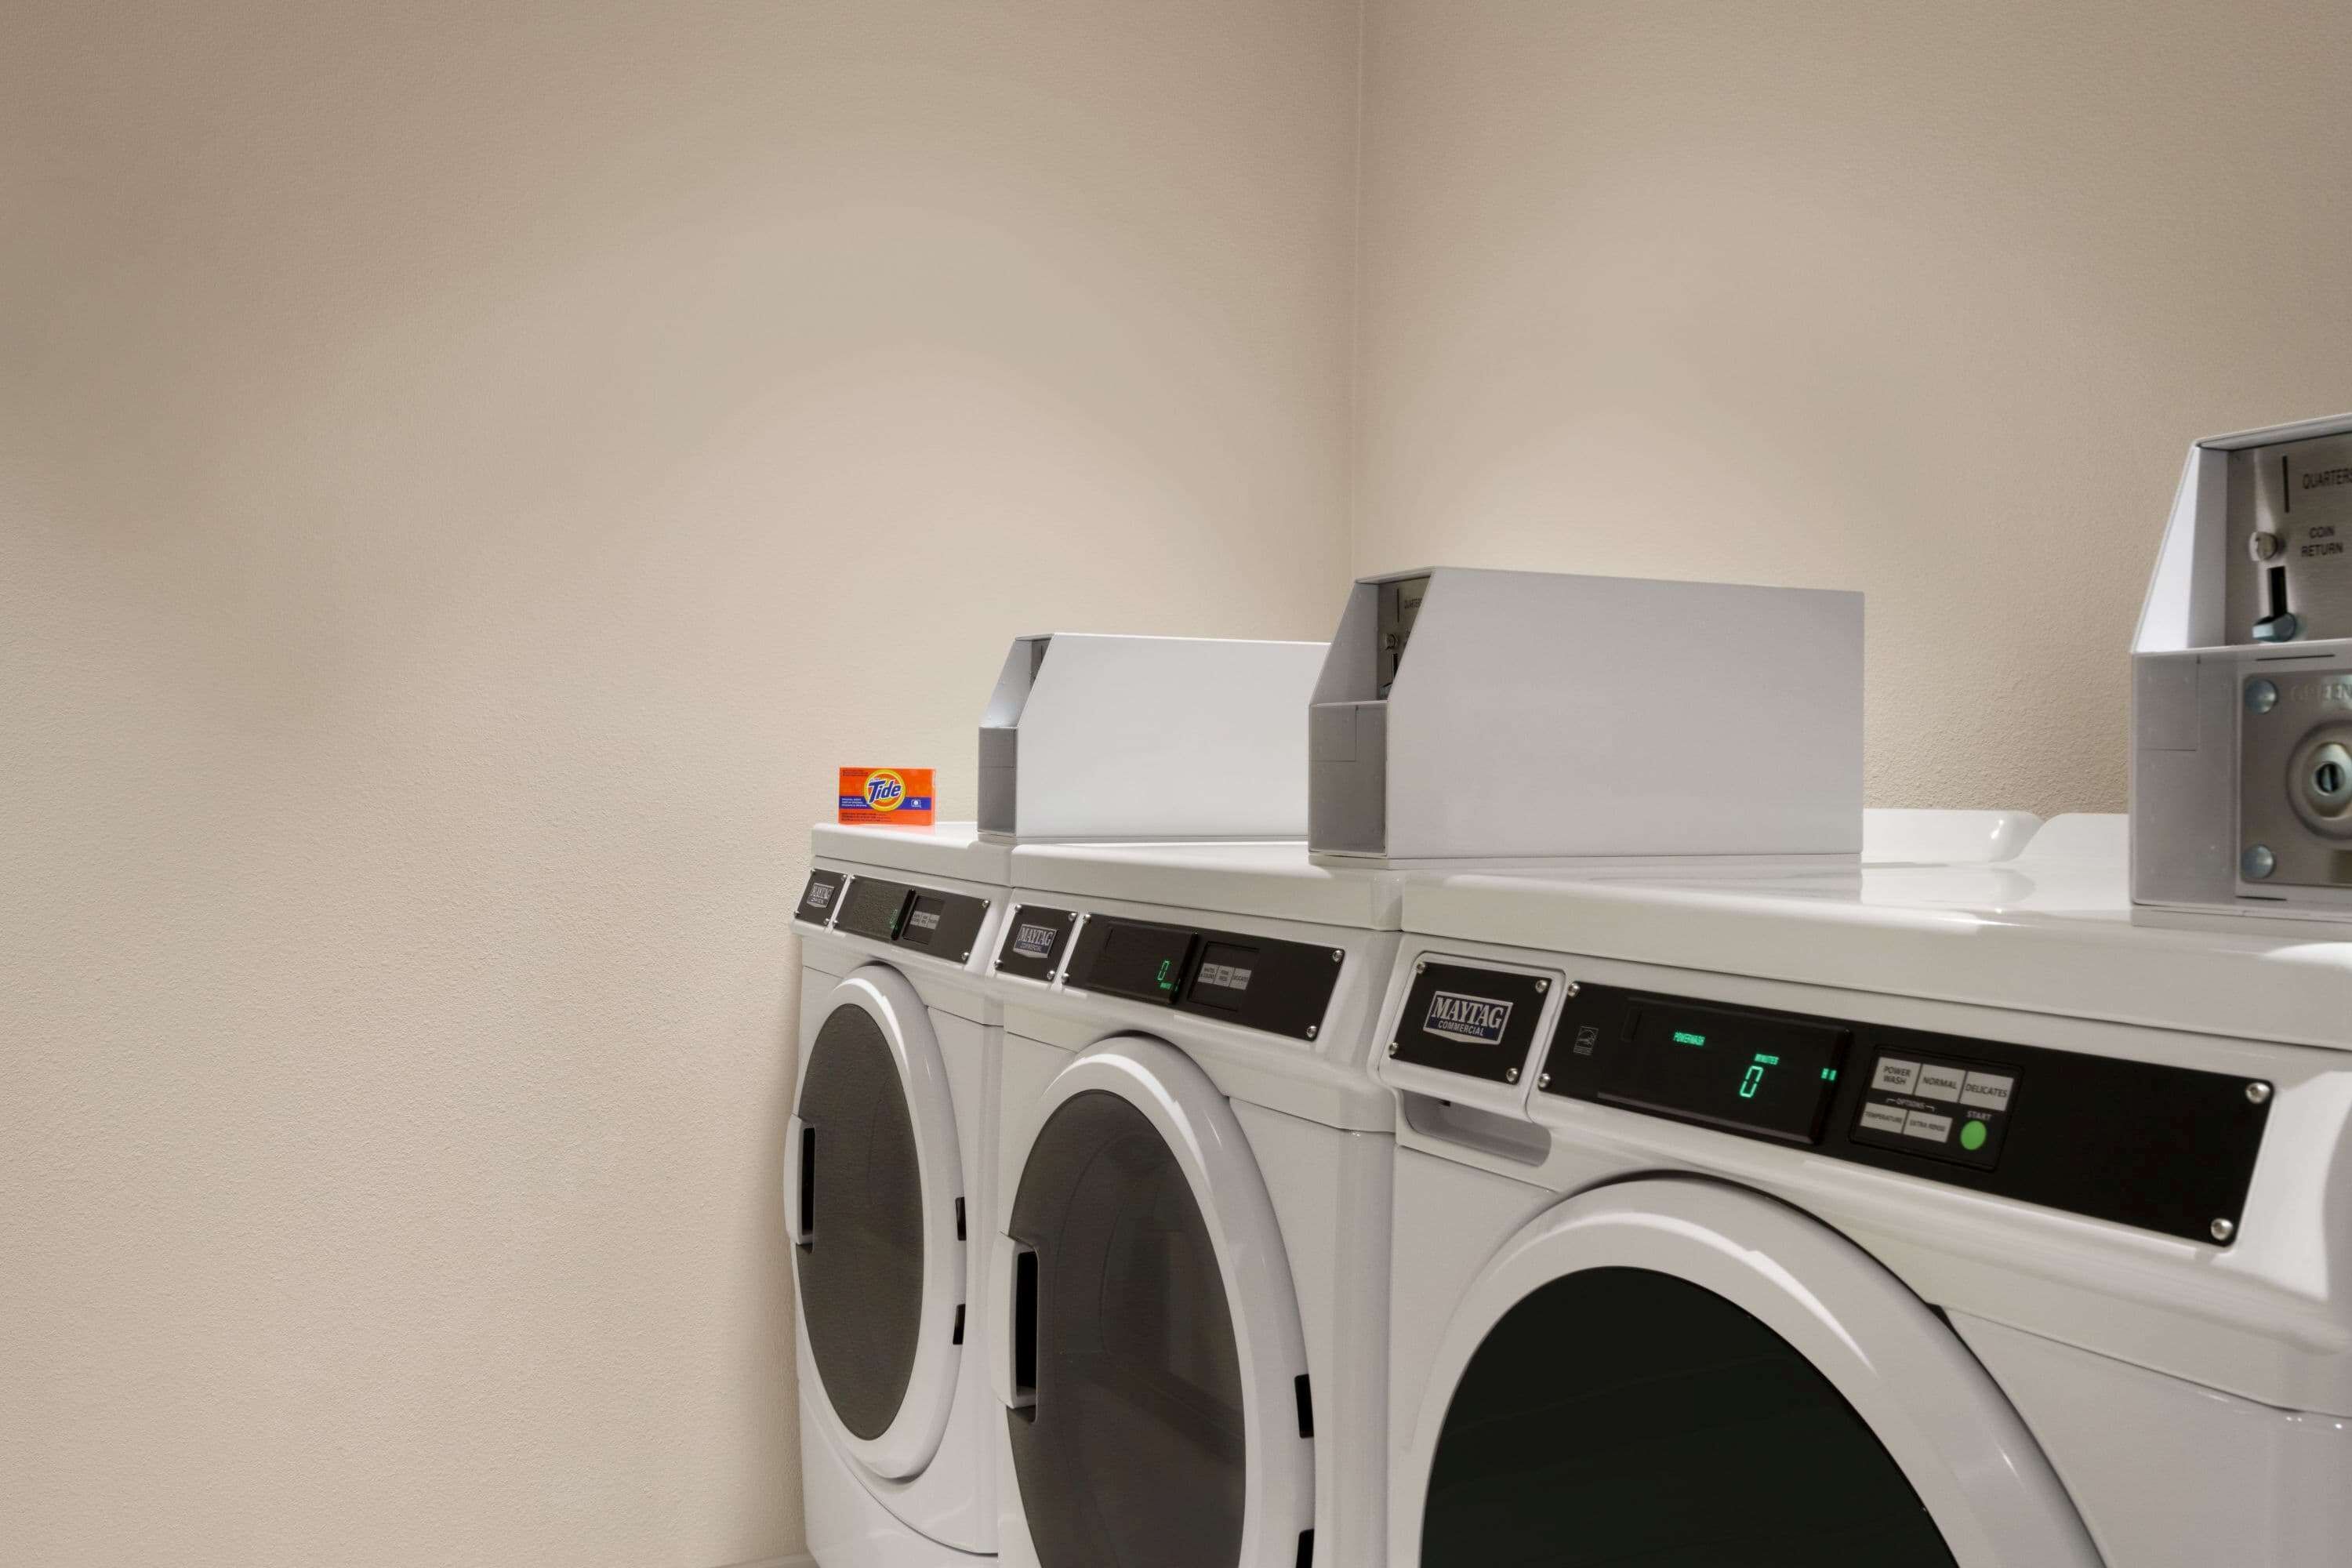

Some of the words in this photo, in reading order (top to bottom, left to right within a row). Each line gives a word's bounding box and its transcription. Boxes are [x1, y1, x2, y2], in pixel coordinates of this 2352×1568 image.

[2309, 526, 2335, 539] COIN
[2301, 543, 2343, 557] RETURN
[868, 780, 902, 803] Tide
[1017, 927, 1054, 946] MAYTAG
[1157, 960, 1170, 981] 0
[1431, 996, 1504, 1029] MAYTAG
[1438, 1020, 1484, 1036] COMMERCIAL
[1883, 1065, 1911, 1077] POWER
[1740, 1065, 1764, 1098] 0
[1883, 1076, 1906, 1086] WASH
[1923, 1077, 1957, 1089] NORMAL
[1965, 1083, 2008, 1098] DELICATES
[1967, 1110, 1991, 1121] START
